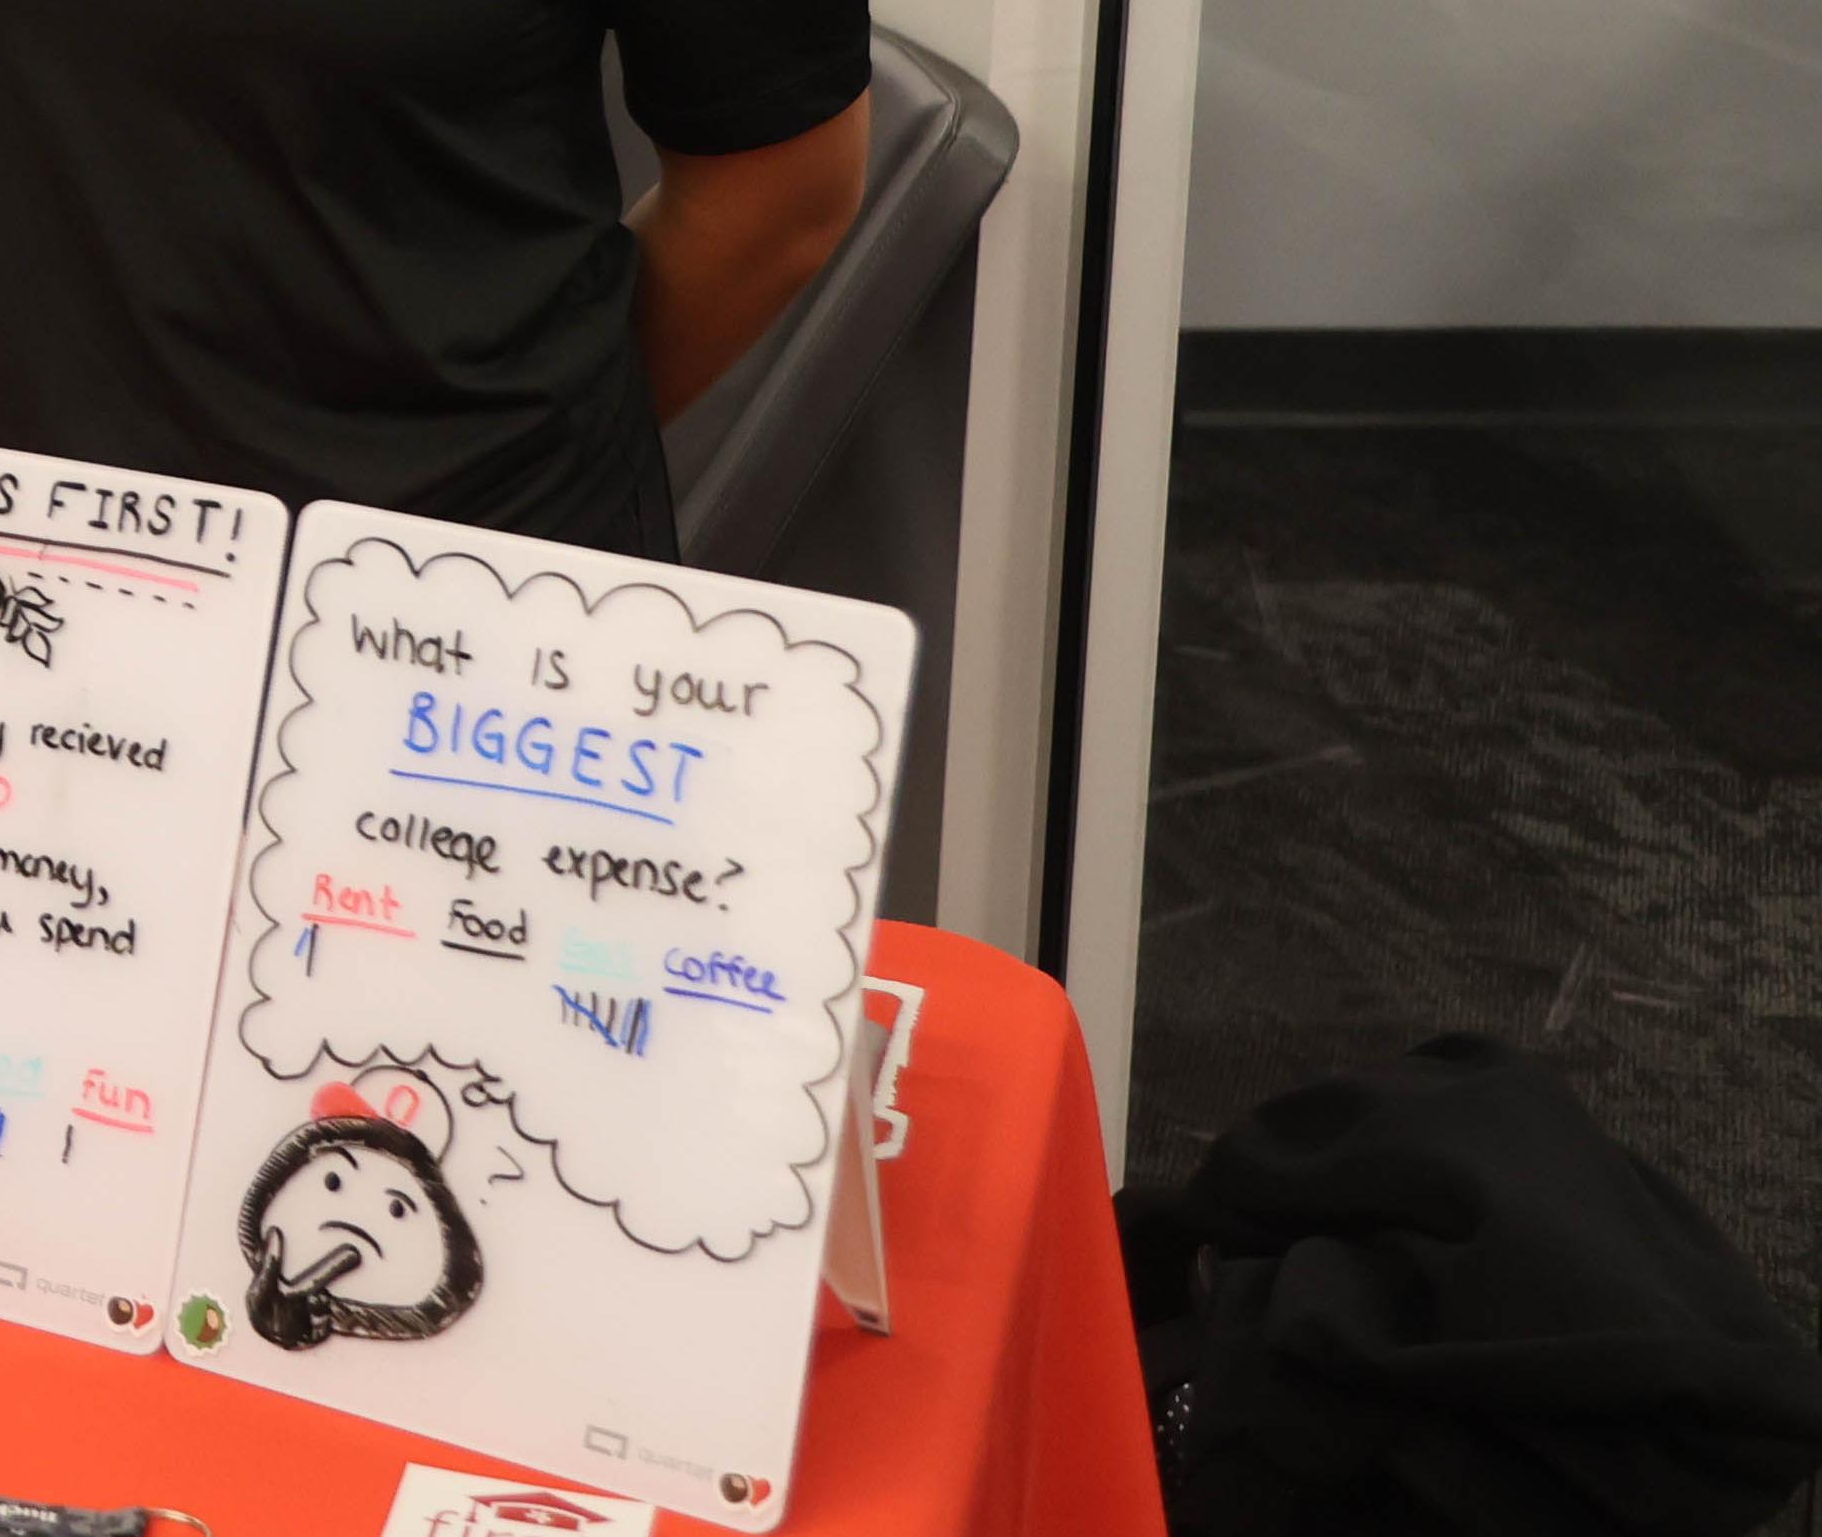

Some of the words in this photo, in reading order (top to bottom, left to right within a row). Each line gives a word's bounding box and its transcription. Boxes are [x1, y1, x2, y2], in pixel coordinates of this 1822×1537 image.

[47, 480, 245, 565] FIRST!
[633, 662, 771, 719] your
[29, 721, 168, 772] recieved
[402, 691, 705, 804] BIGGEST
[355, 808, 502, 881] college
[541, 847, 747, 914] expense?
[39, 910, 137, 958] spend
[311, 872, 405, 921] Rent
[446, 898, 531, 947] Food
[663, 945, 787, 1003] Coffee
[80, 1067, 152, 1120] Fun
